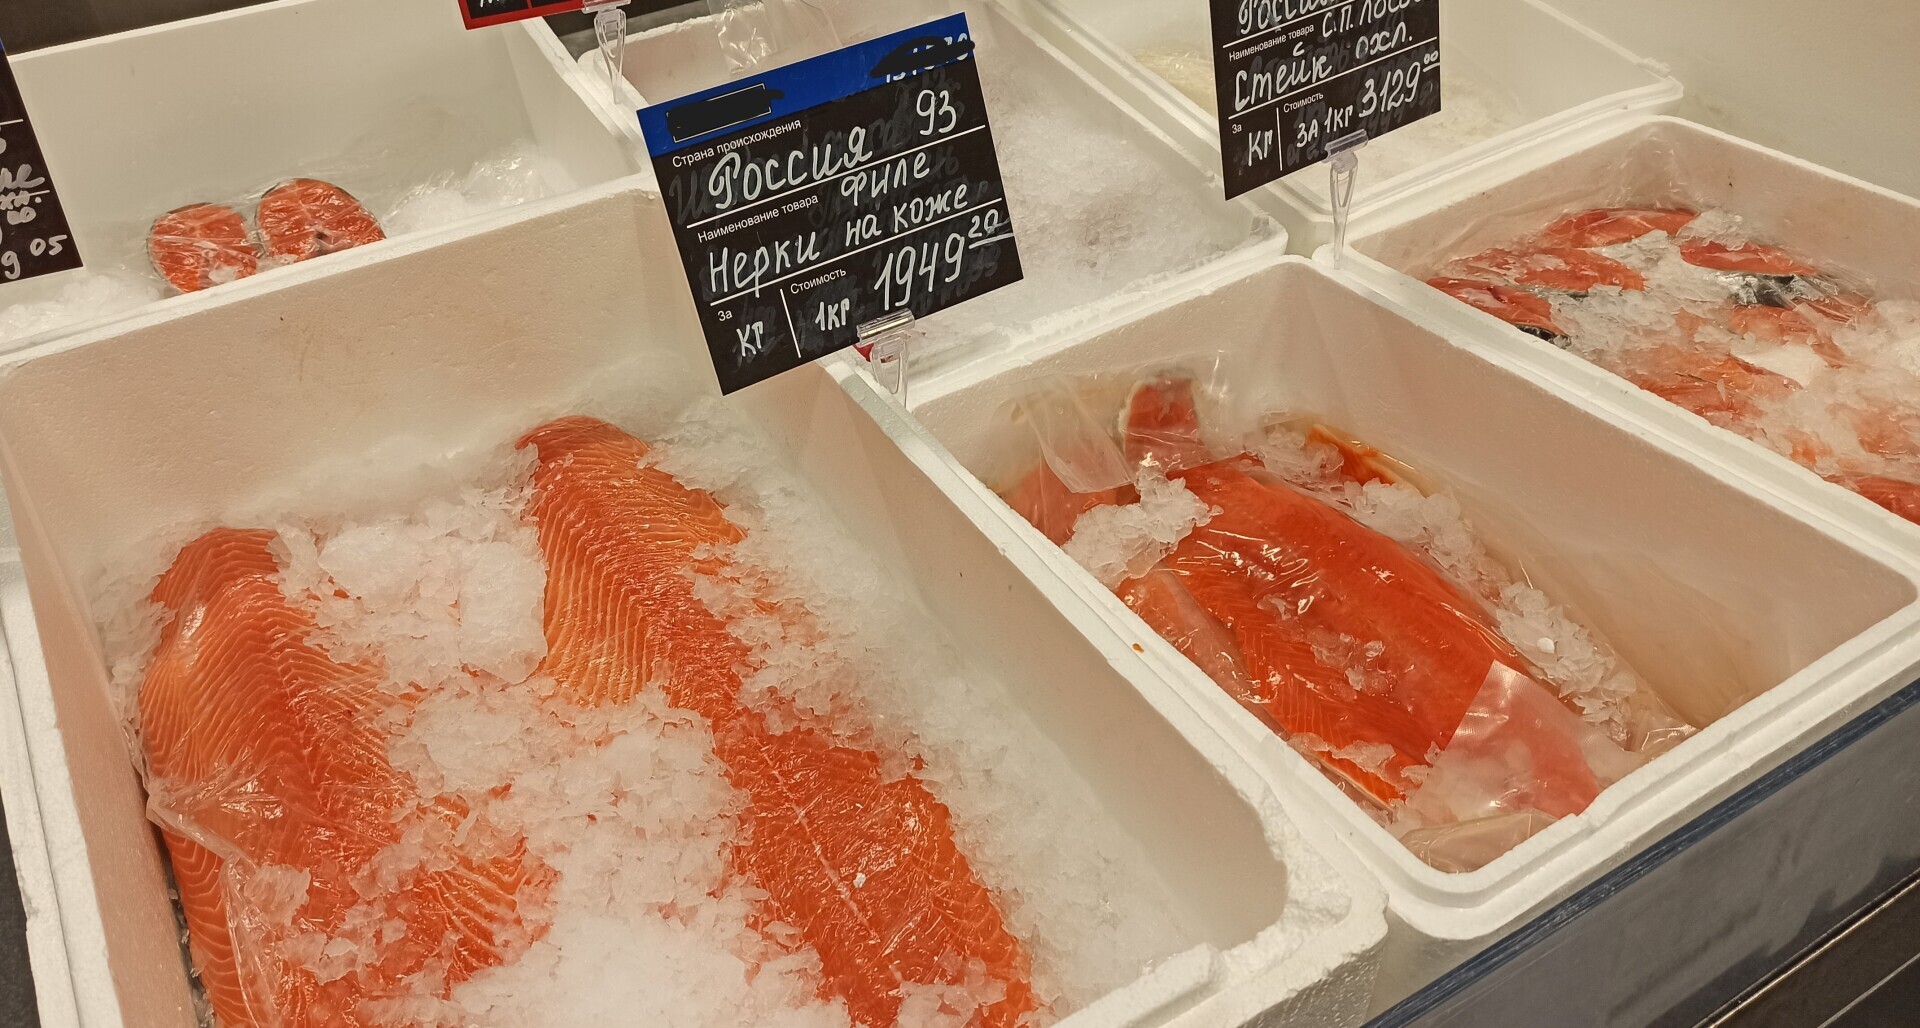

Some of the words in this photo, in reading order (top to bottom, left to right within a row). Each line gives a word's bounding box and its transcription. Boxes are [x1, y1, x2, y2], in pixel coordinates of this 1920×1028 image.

[1228, 35, 1287, 62] Наименование
[1288, 24, 1315, 42] товара
[1234, 42, 1332, 111] Стейк
[1355, 21, 1413, 59] охл.
[1283, 92, 1324, 114] Стоимость
[672, 146, 715, 168] Страна
[716, 119, 802, 157] происхождения
[708, 126, 873, 209] Россия
[916, 89, 957, 136] 93
[1231, 123, 1242, 135] За
[698, 208, 781, 243] Наименование
[782, 194, 819, 220] товара
[709, 231, 820, 298] Нерки
[846, 214, 882, 247] на
[893, 183, 968, 234] коже
[790, 267, 847, 295] Стоимость
[718, 309, 733, 322] За
